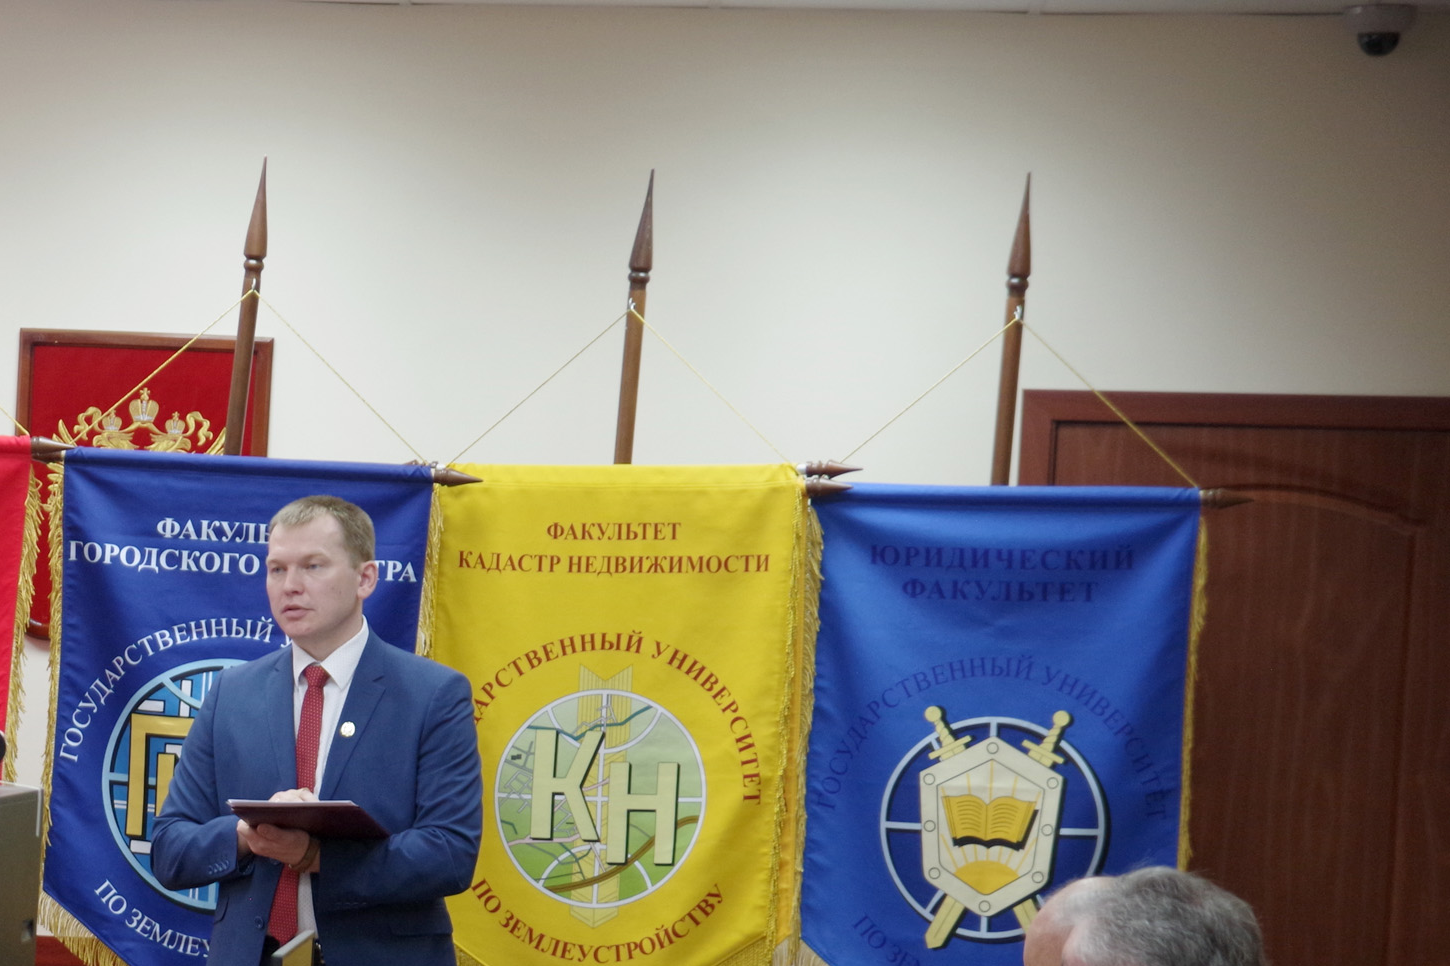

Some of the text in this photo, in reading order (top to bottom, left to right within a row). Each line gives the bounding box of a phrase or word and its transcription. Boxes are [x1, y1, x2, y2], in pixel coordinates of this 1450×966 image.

[546, 521, 682, 542] ФАКУЛЬТЕТ
[68, 540, 260, 575] ГОРОДСКОГО
[458, 550, 771, 576] КАДАСТР НЕДВИЖИМОСТИ
[870, 543, 1135, 573] ЮРИДИЧЕСКИЙ
[901, 577, 1100, 603] ФАКУЛЬТЕТ
[59, 616, 274, 763] ГОСУДАРСТВЕННЫЙ
[651, 640, 762, 805] УНИВЕРСИТЕТ
[815, 653, 1169, 820] ГОСУДАРСТВЕННЫЙ УНИВЕРСИТЕТ
[94, 879, 128, 916] ПО
[471, 877, 725, 964] ПО ЗЕМЛЕУСТРОЙСТВУ
[853, 914, 886, 951] ПО
